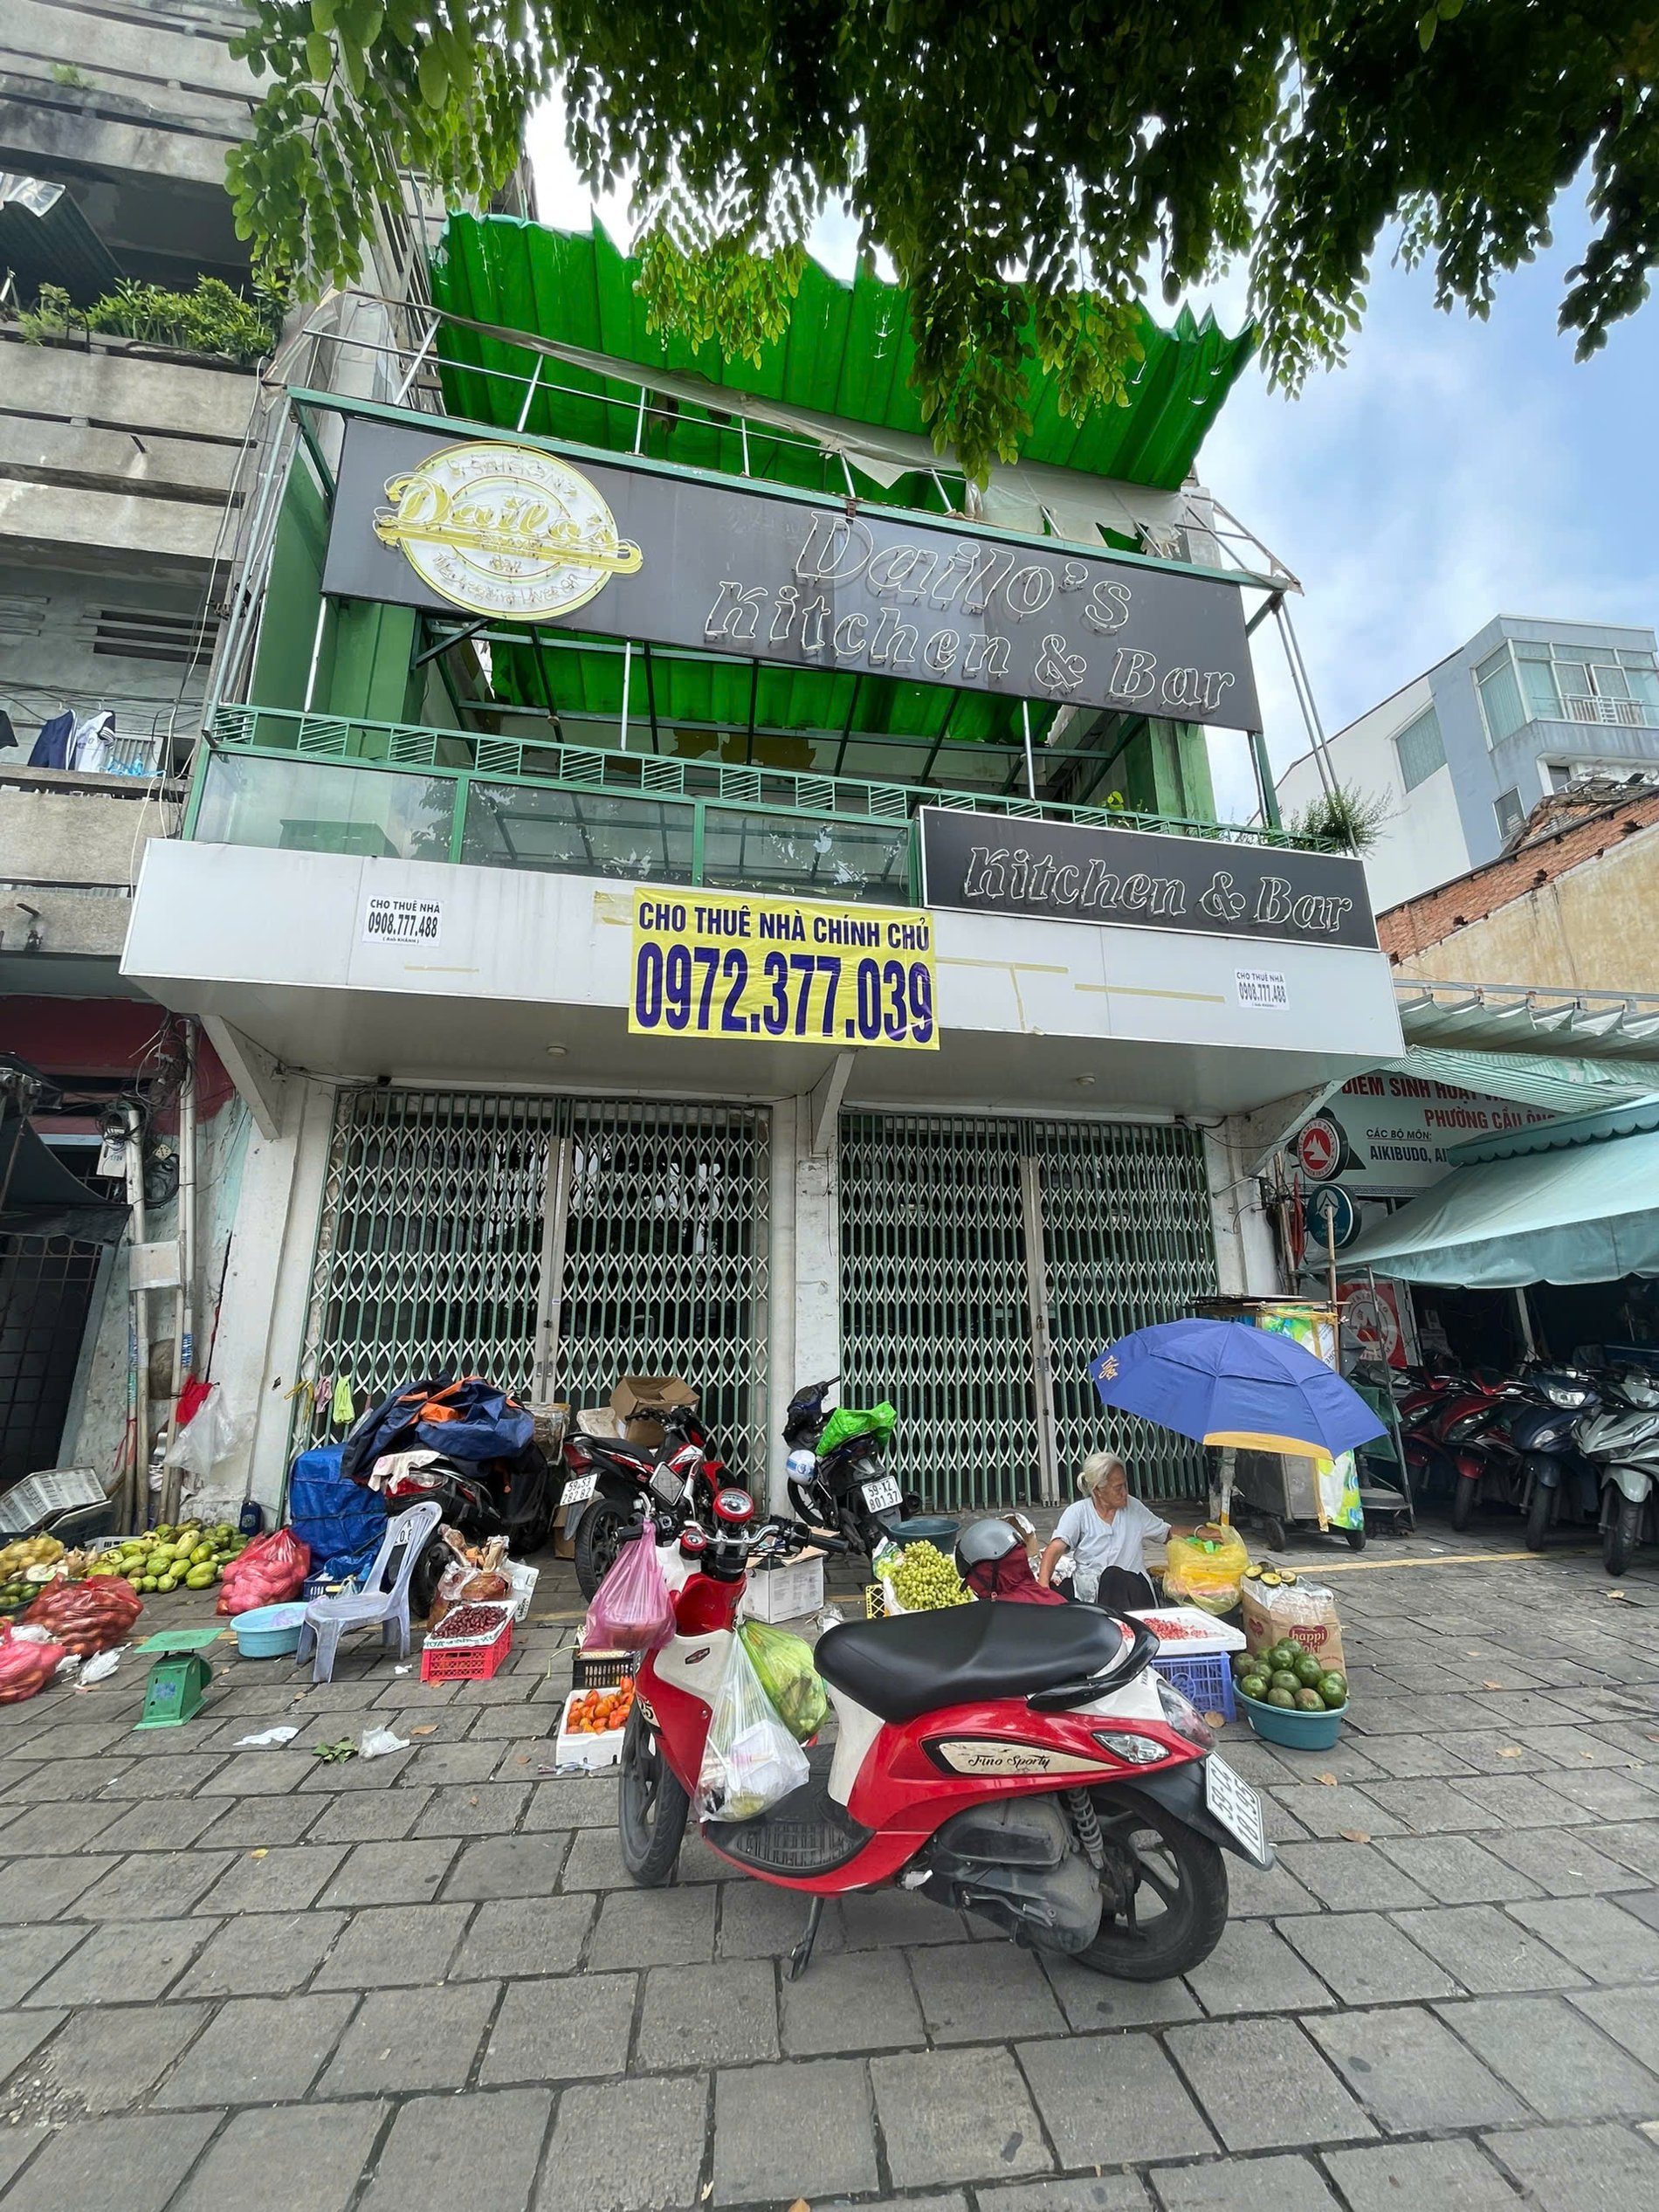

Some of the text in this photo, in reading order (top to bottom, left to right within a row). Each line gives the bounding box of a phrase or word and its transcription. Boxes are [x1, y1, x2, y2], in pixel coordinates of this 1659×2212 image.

[795, 511, 1132, 629] Dailo's
[705, 581, 1235, 708] Kitchen & Bar
[964, 846, 1353, 932] Kitchen & Bar
[370, 899, 440, 913] CHO THUÊ NHÀ
[368, 911, 438, 938] 0908.777.488
[639, 902, 930, 951] CHO THUÊ NHÀ CHÍNH CHỦ
[636, 941, 933, 1043] 0972.377.039
[1239, 982, 1286, 1003] 0908.777.488
[1389, 1078, 1431, 1098] SINH
[1424, 1106, 1488, 1129] PHƯỜNG
[1366, 1127, 1387, 1137] CÁC
[1371, 1146, 1431, 1163] AIKIBUDO,
[868, 1480, 892, 1497] 59-X2
[869, 1491, 898, 1510] 801.37
[1292, 1630, 1325, 1643] happi
[967, 1754, 1051, 1769] Fino Sporty
